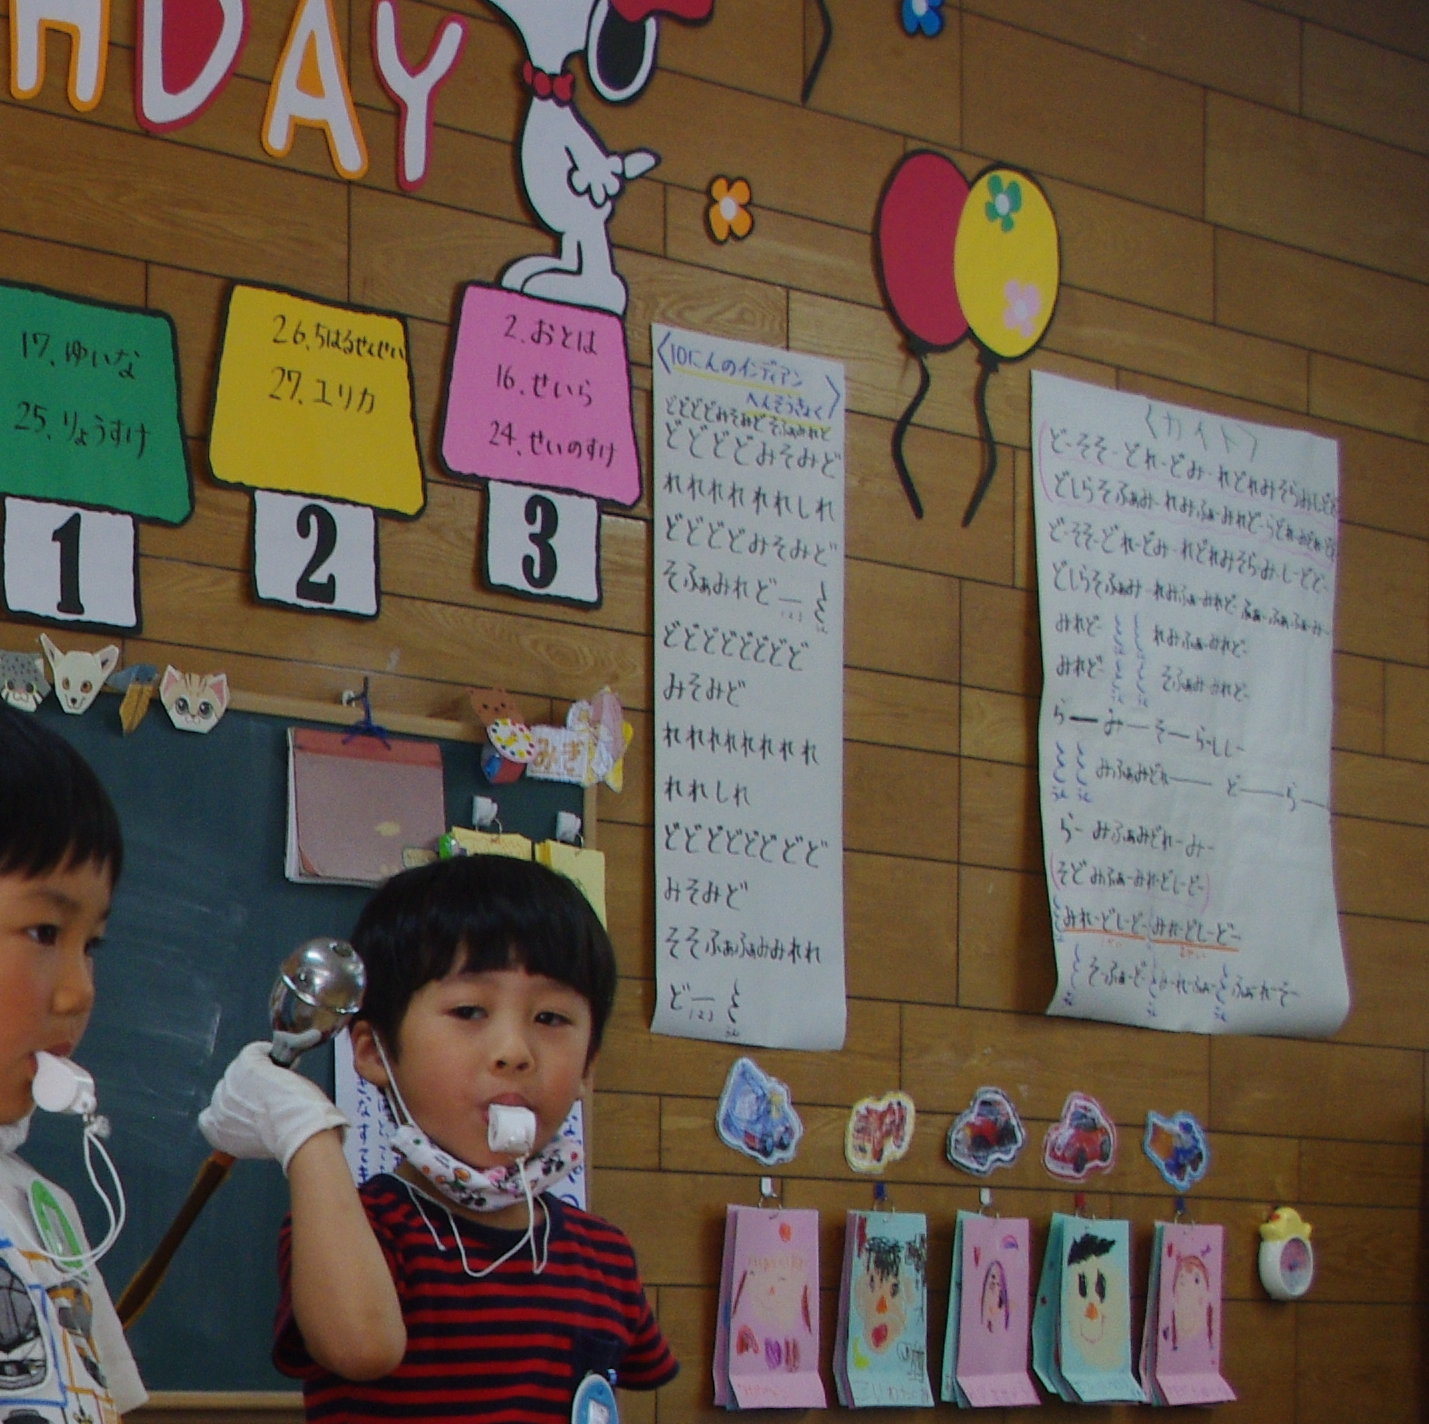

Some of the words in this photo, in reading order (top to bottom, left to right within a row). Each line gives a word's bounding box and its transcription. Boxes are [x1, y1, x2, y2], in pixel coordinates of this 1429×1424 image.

[51, 511, 86, 616] 1
[295, 503, 338, 600] 2
[521, 494, 559, 589] 3
